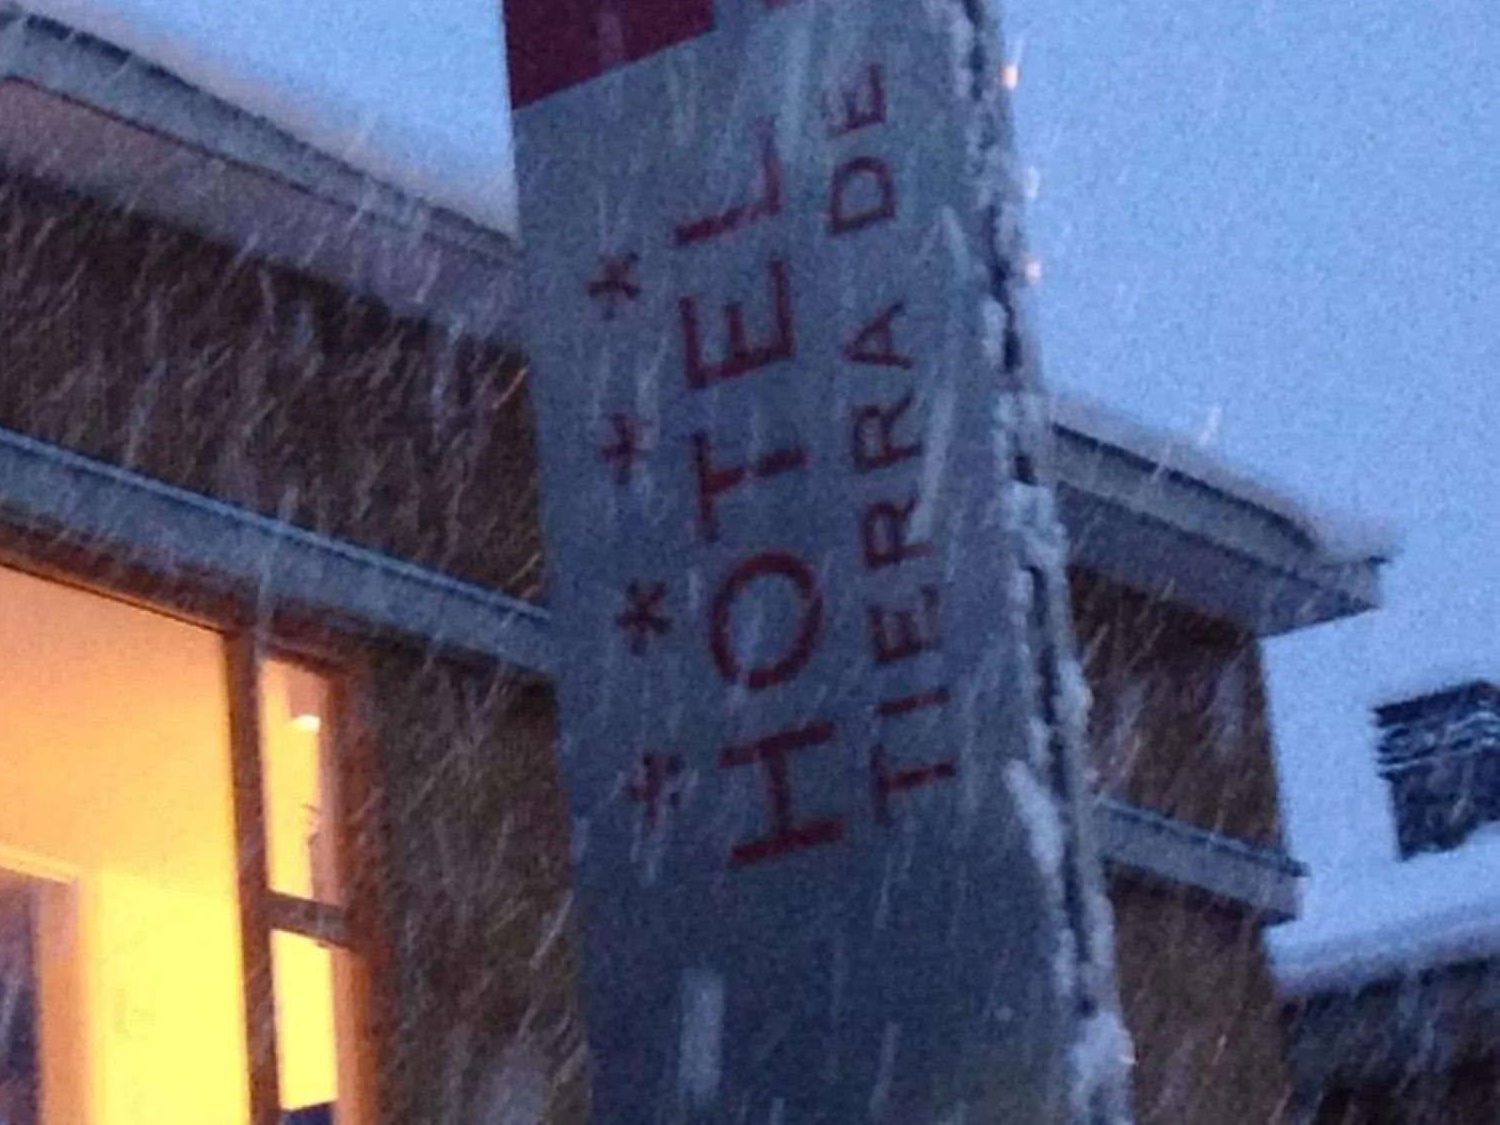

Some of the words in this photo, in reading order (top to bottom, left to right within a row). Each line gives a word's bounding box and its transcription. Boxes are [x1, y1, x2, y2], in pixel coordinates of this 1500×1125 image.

[825, 62, 896, 237] DE
[673, 117, 845, 867] HOTEL
[842, 299, 957, 828] TIERRA
